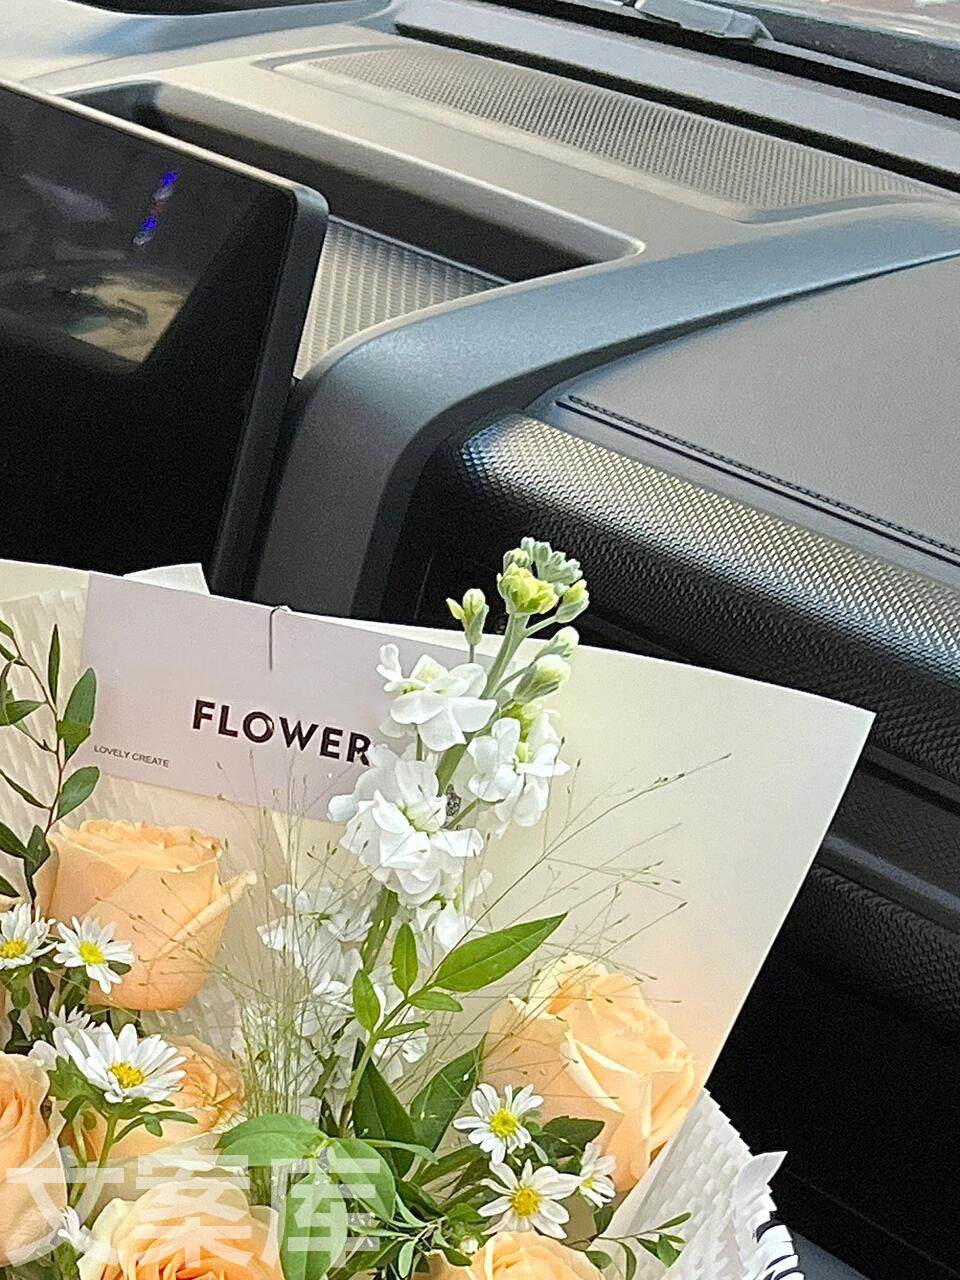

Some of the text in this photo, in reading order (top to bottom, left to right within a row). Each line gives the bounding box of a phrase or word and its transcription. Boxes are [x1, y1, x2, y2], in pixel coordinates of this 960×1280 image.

[93, 744, 170, 768] LOVELY CREATE
[192, 699, 372, 767] FLOWER
